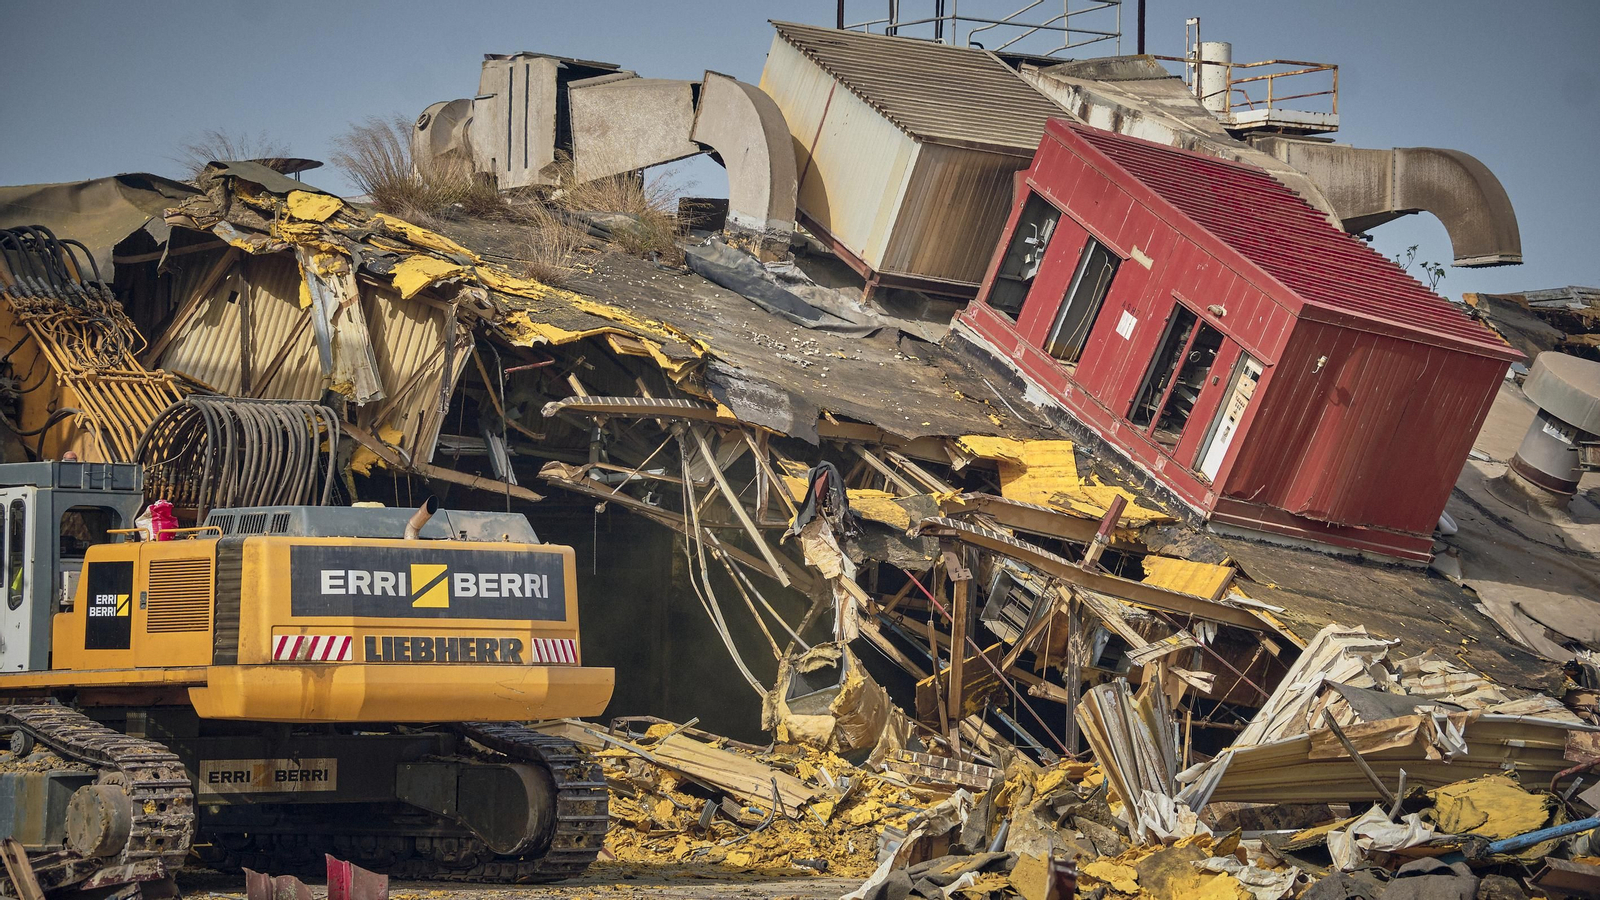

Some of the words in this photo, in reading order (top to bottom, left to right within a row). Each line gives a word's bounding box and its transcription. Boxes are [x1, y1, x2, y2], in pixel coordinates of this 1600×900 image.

[320, 569, 407, 597] ERRI
[453, 572, 549, 599] BERRI
[95, 594, 117, 605] ERRI
[89, 606, 117, 617] BERRI
[364, 635, 525, 664] LIEBHERR
[208, 770, 251, 784] ERRI
[274, 769, 329, 782] BERRI
